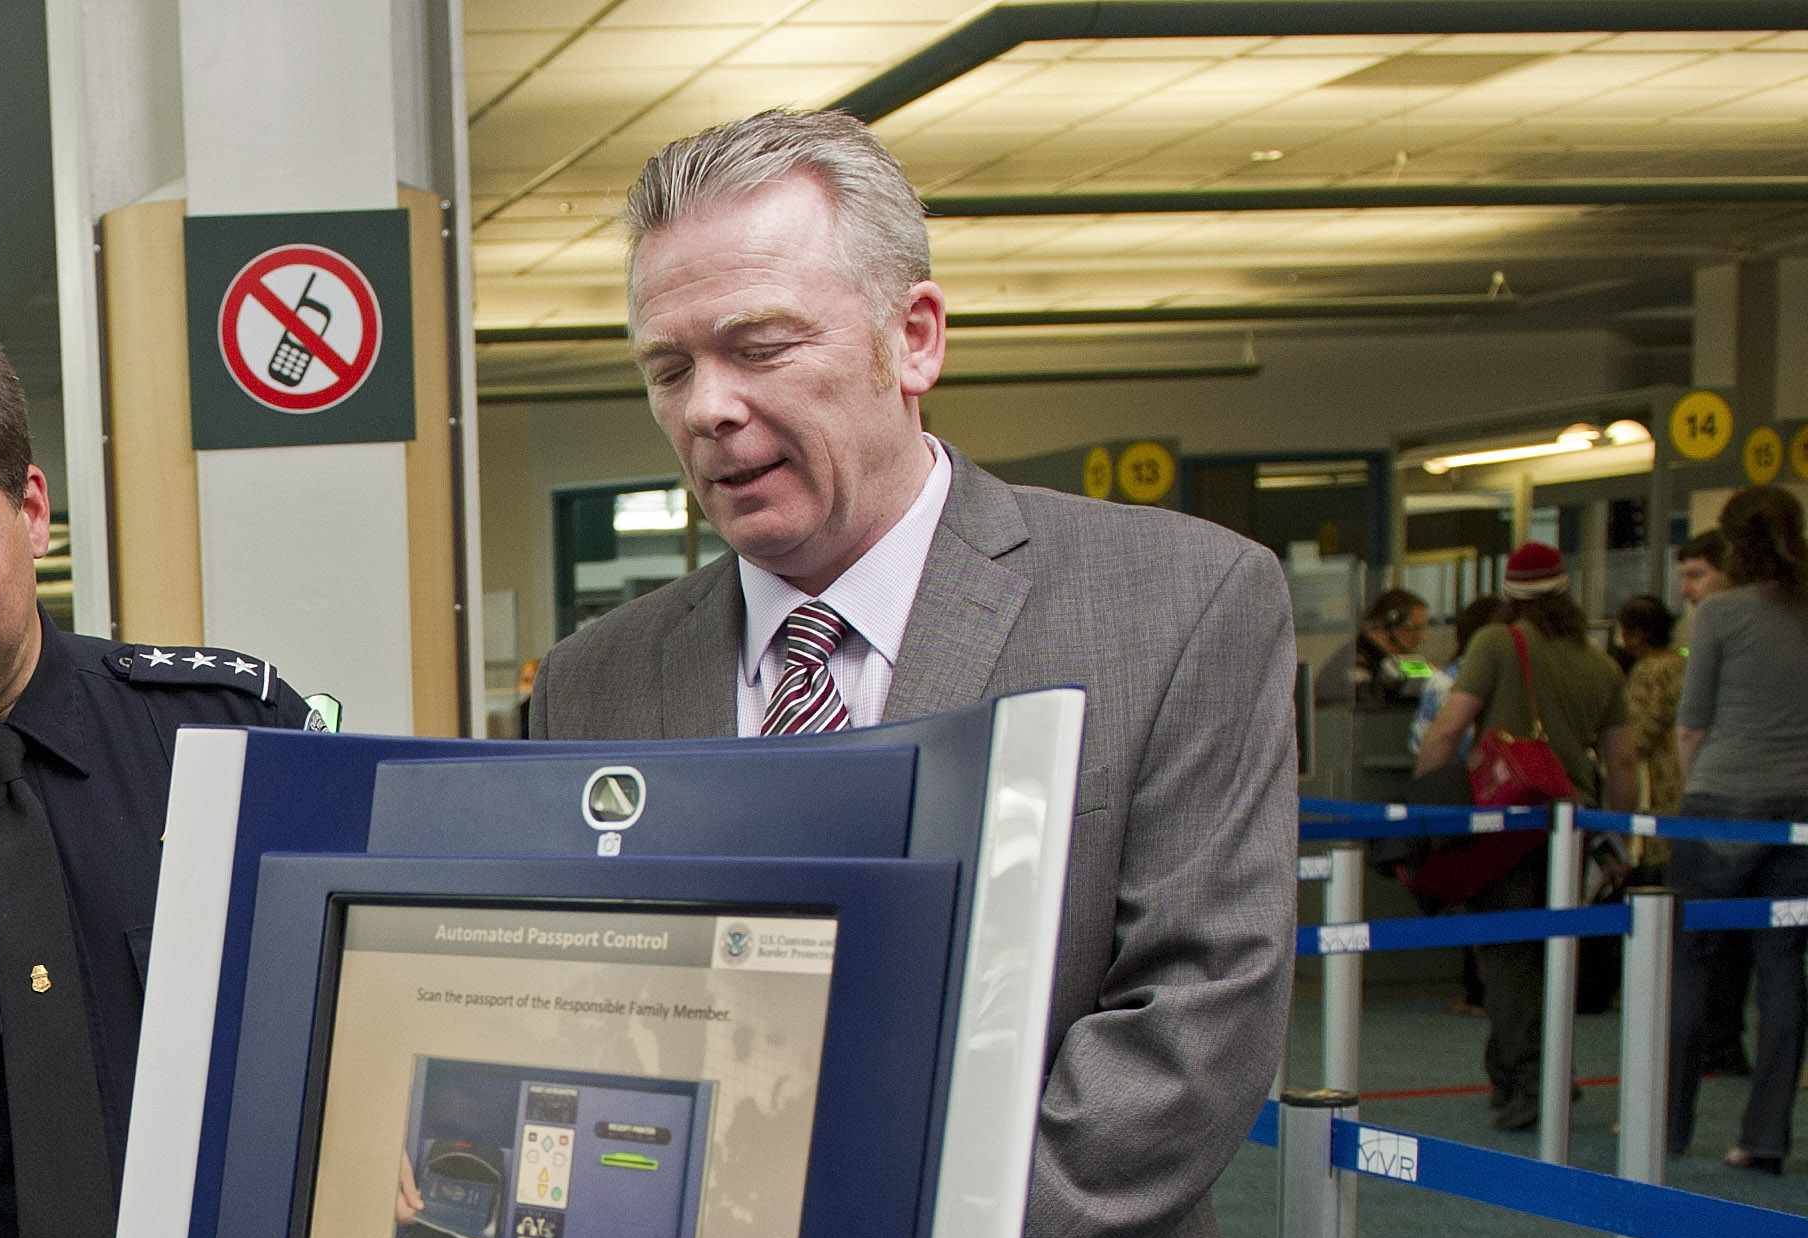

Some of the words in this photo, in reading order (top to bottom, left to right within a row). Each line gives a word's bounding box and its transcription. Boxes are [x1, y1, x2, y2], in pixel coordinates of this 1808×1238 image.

[1687, 412, 1717, 438] 14
[1134, 459, 1160, 484] 13
[434, 924, 525, 943] Automated
[528, 927, 599, 951] Passport
[603, 930, 668, 950] Control
[417, 987, 441, 1002] Scan
[445, 991, 463, 1004] the
[465, 994, 513, 1008] passport
[517, 994, 530, 1008] of
[532, 996, 551, 1009] the
[553, 997, 626, 1016] Responsible
[630, 1001, 670, 1019] Family
[673, 1004, 731, 1021] Member.
[1358, 1144, 1417, 1183] YVR
